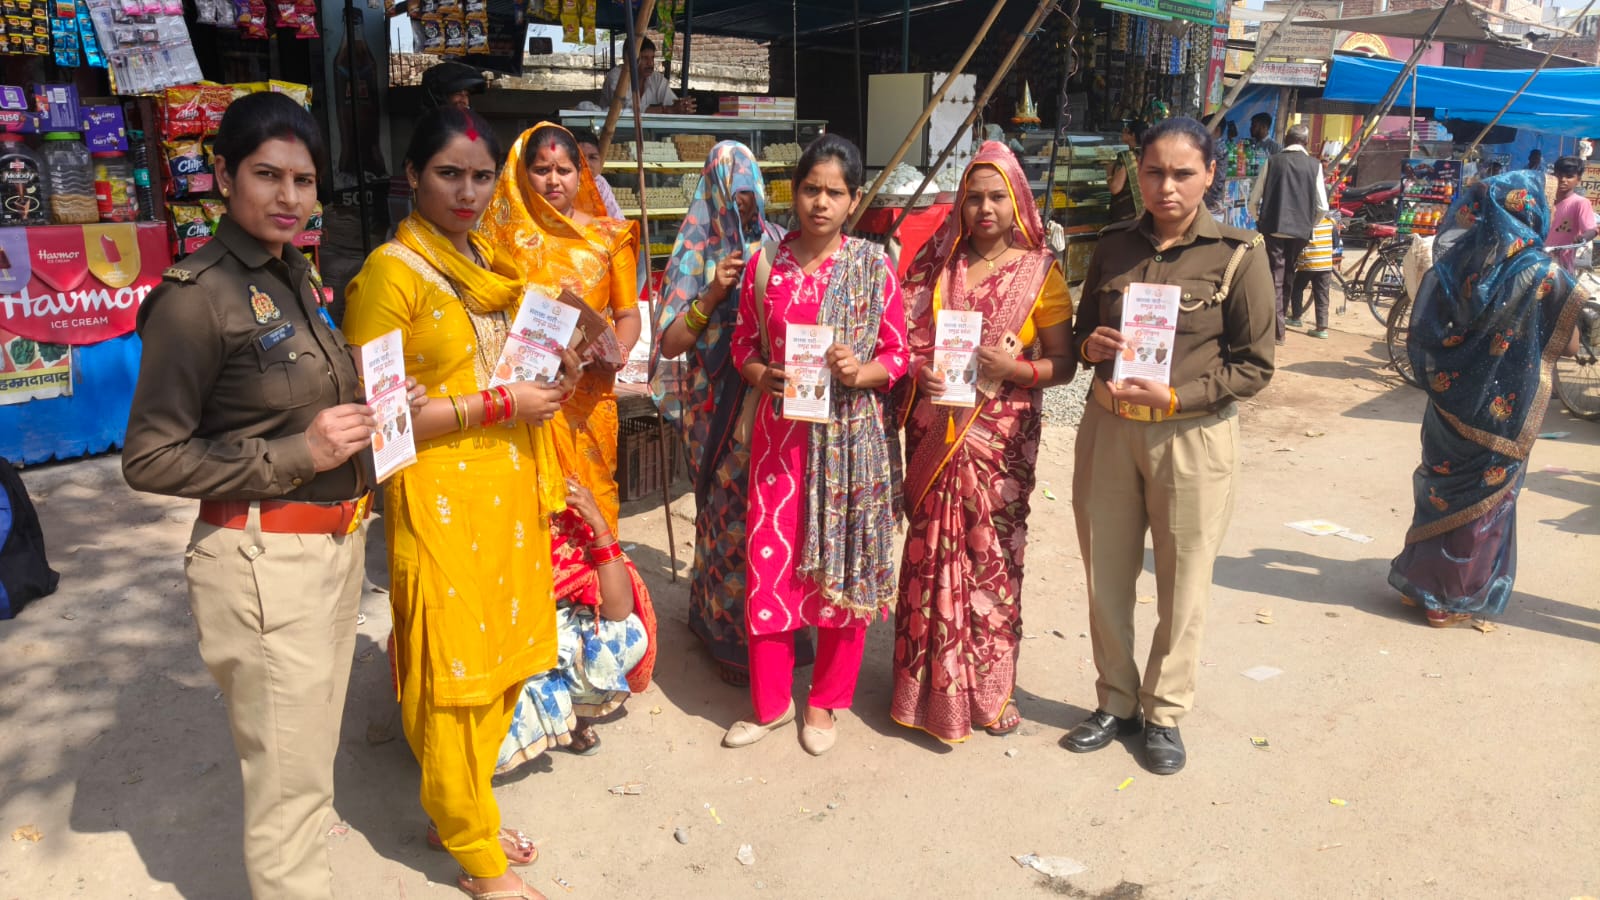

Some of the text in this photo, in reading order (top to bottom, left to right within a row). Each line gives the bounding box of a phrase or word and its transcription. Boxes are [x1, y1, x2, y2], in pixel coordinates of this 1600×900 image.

[37, 249, 80, 260] Havmor
[0, 285, 153, 319] Havmor
[51, 316, 109, 329] ICE CREAM
